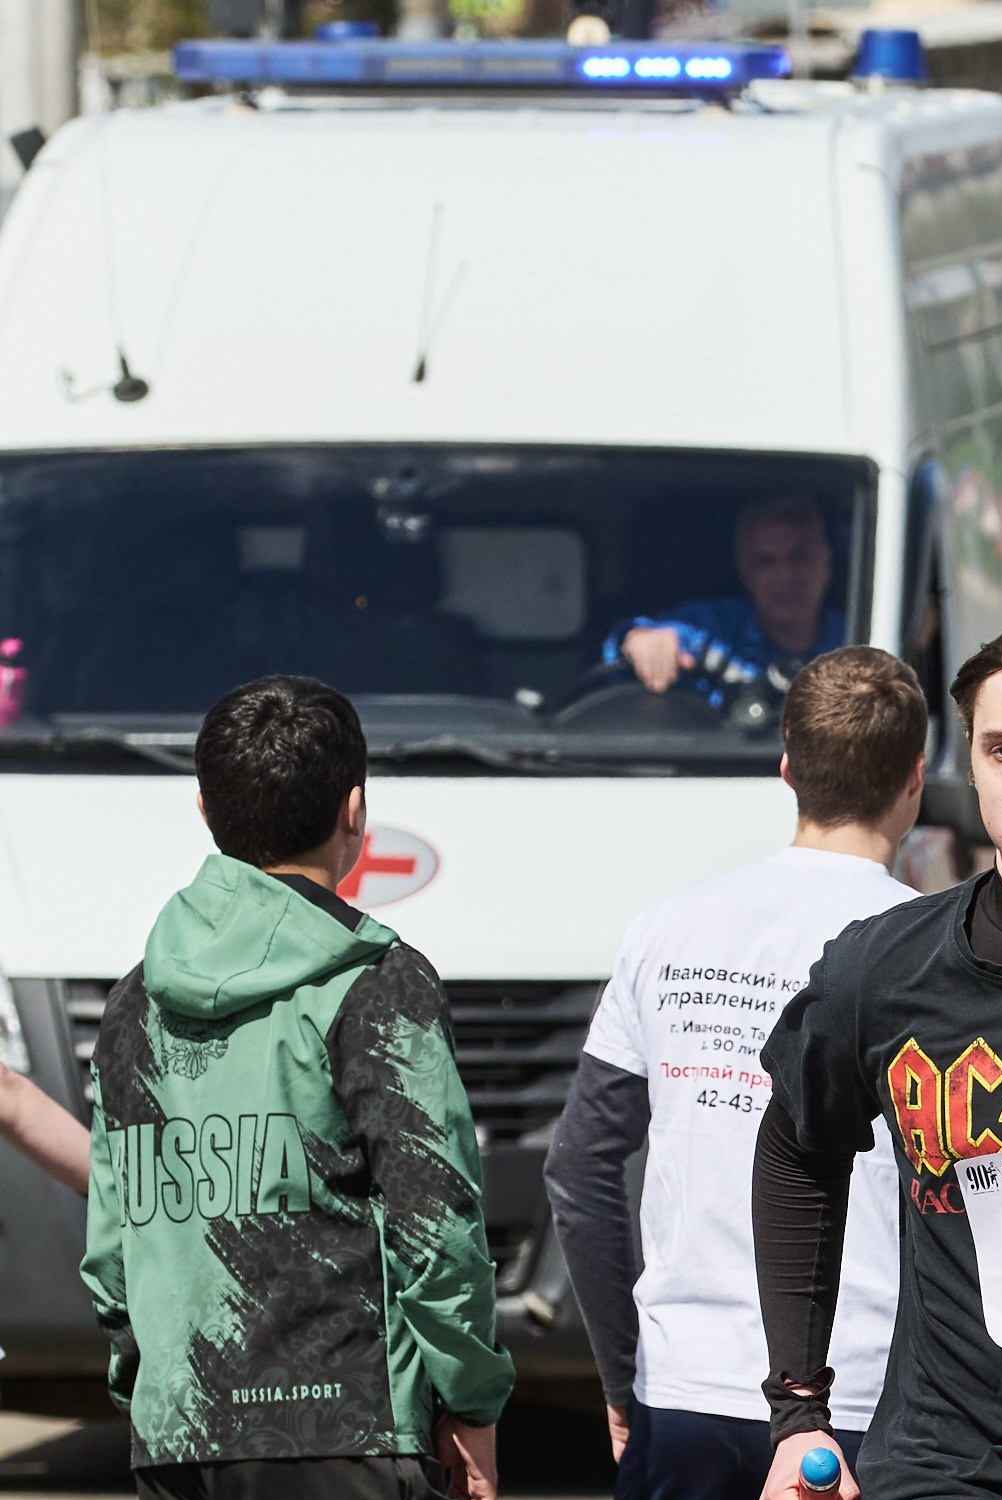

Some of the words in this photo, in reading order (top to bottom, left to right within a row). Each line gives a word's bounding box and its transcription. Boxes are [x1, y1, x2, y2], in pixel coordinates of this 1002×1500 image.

[658, 964, 776, 989] Ивановский
[657, 991, 776, 1013] управления
[683, 1021, 745, 1039] Иваново,
[713, 1038, 734, 1051] 90
[696, 1090, 770, 1113] 42-43-
[107, 1112, 311, 1229] RUSSIA
[966, 1164, 991, 1191] 90
[232, 1382, 343, 1404] RUSSIA.SPORT
